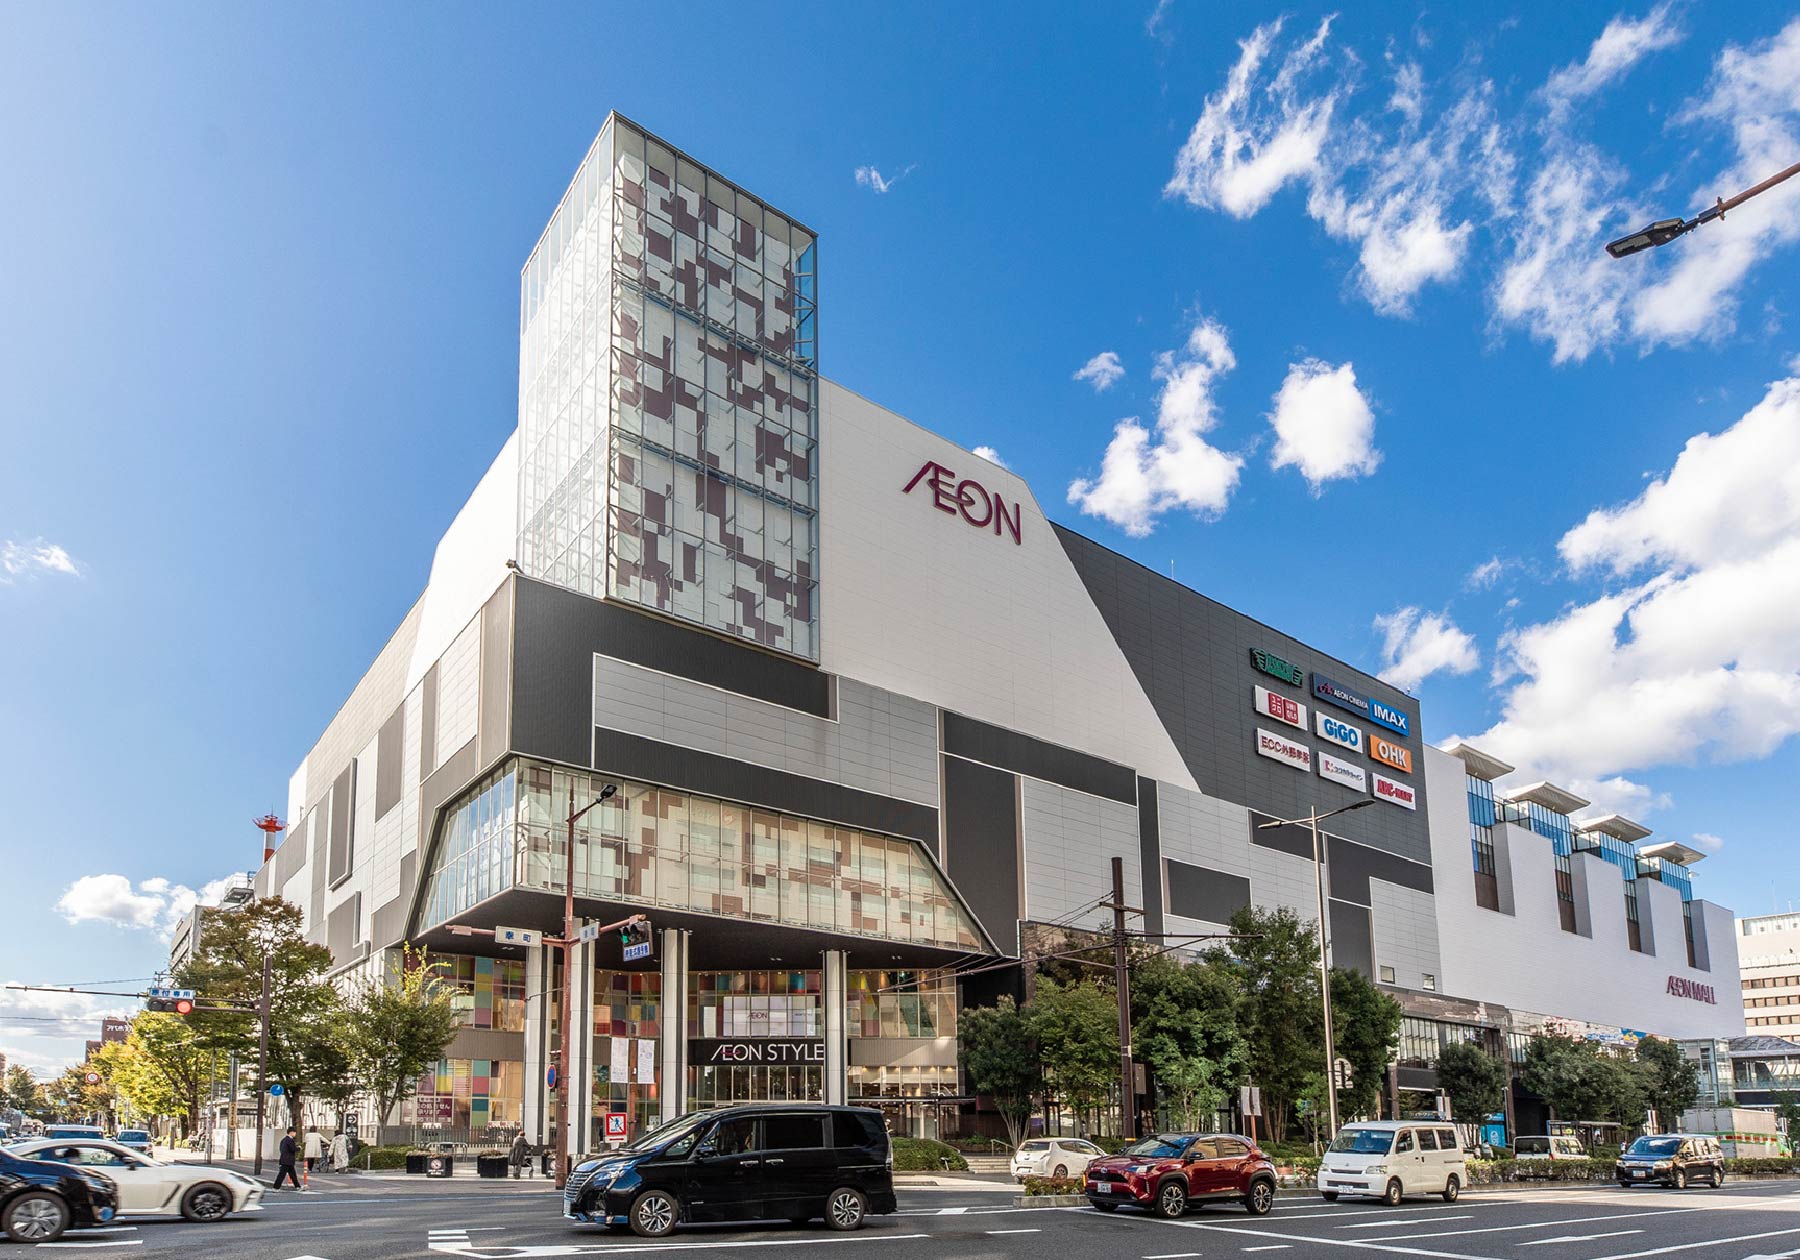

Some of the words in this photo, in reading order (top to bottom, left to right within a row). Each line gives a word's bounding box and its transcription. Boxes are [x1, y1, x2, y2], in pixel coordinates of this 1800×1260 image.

[1373, 703, 1407, 729] IMAX
[1378, 741, 1407, 768] OHK
[767, 1044, 825, 1061] STYLE
